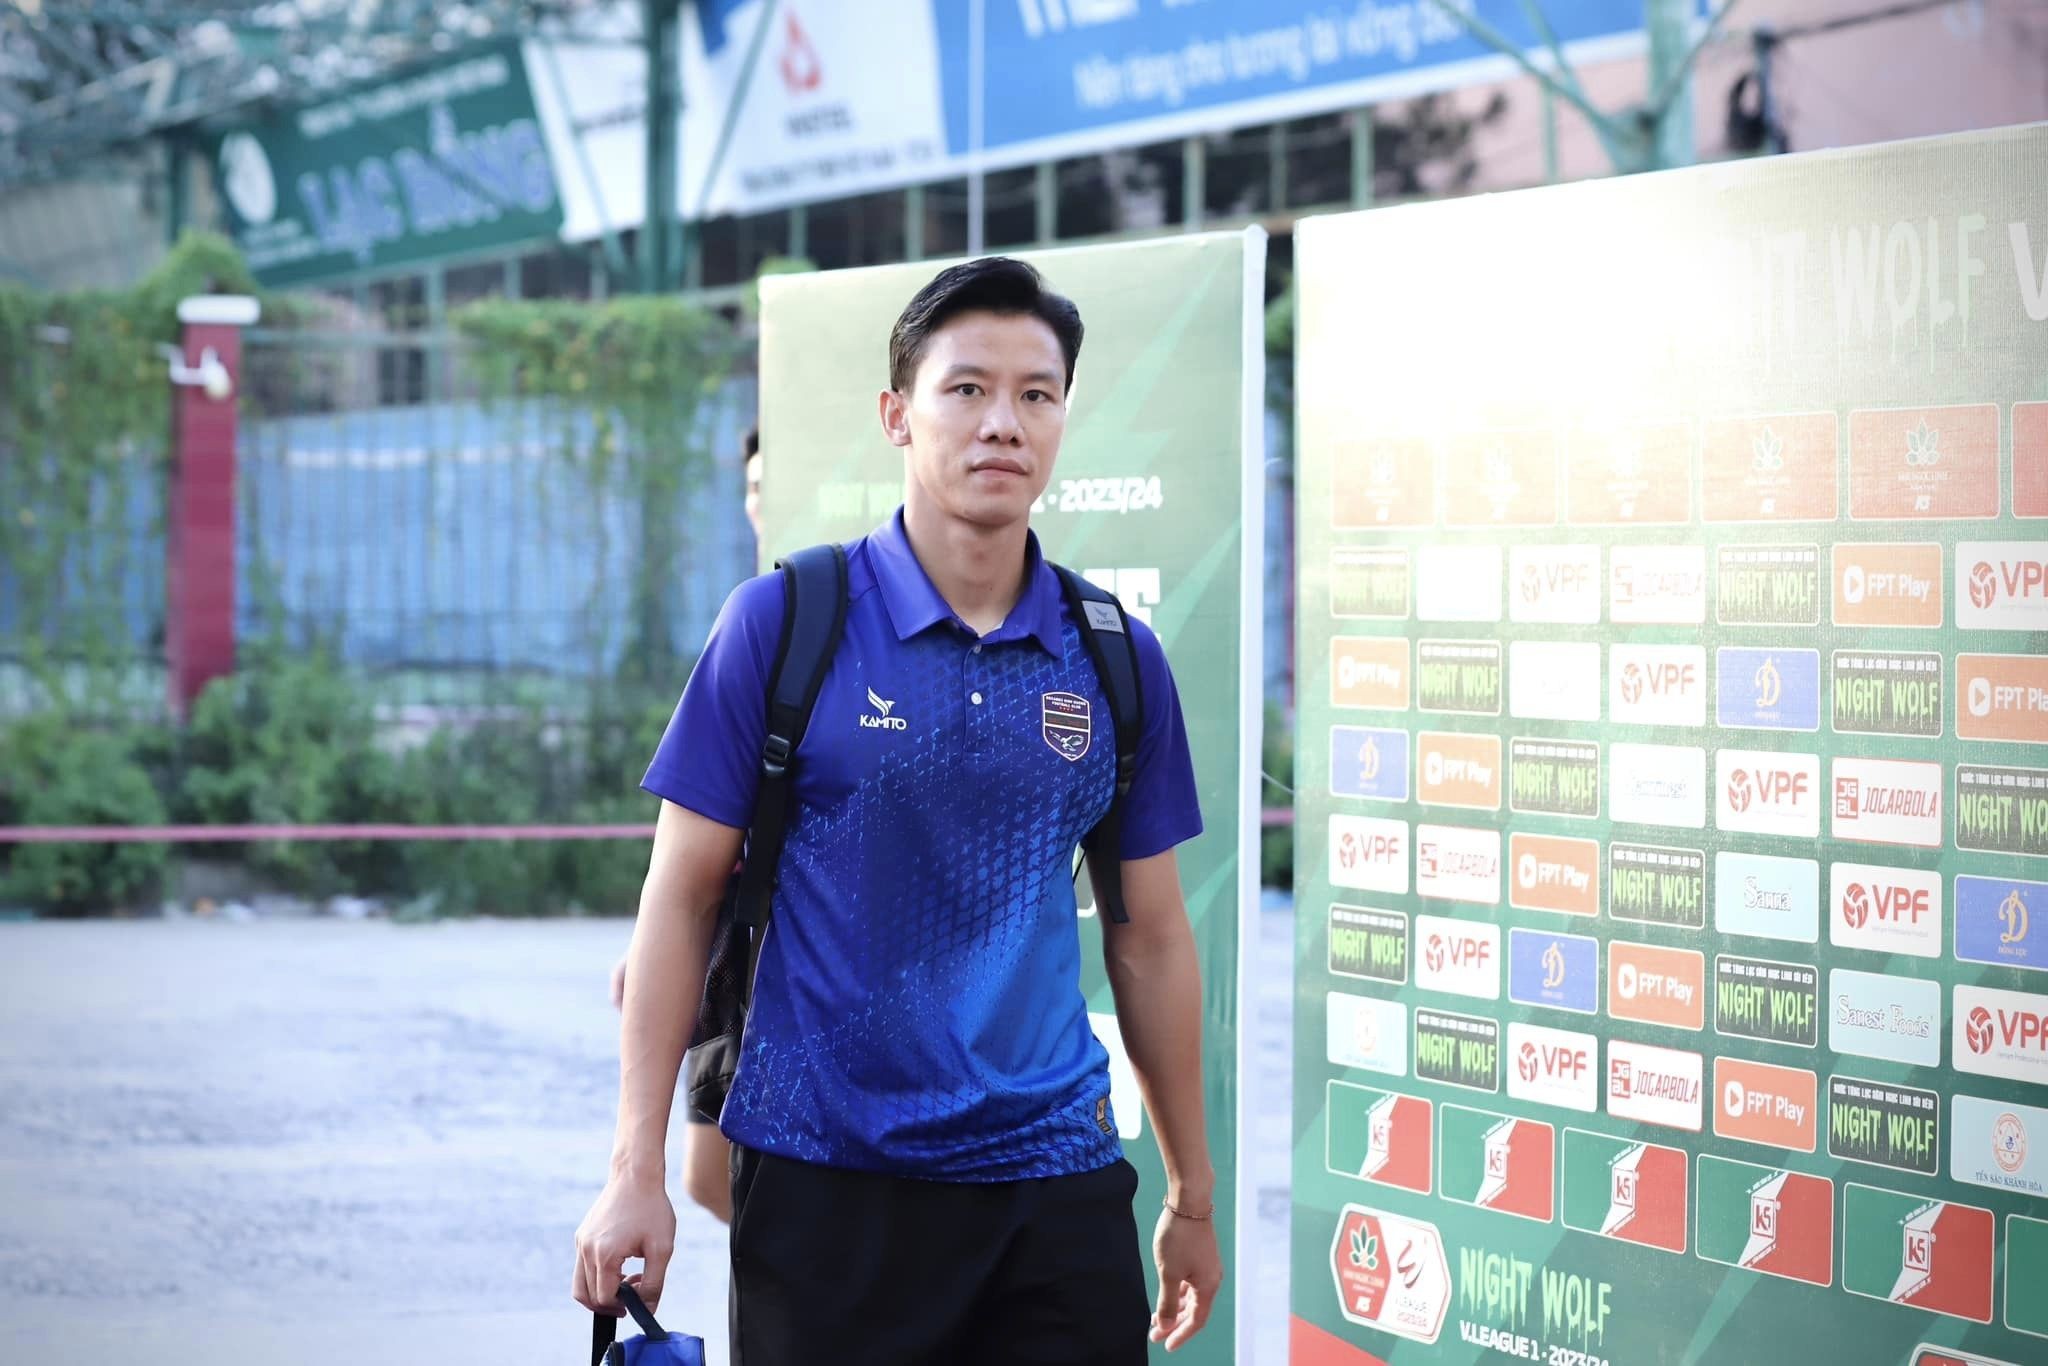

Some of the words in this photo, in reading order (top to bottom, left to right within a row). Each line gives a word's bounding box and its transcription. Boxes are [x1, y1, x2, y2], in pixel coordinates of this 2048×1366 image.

[1831, 214, 1986, 370] WOLF
[1060, 476, 1163, 514] 2023/24
[1719, 567, 1767, 612] NIGHT
[1772, 569, 1815, 612] WOLF
[1867, 573, 1896, 597] FPT
[1899, 573, 1932, 603] Play
[2000, 560, 2048, 598] VP
[1647, 663, 1695, 694] VPF
[1836, 675, 1884, 727] NIGHT
[1892, 679, 1938, 729] WOLF
[1995, 686, 2024, 710] FPT
[860, 713, 907, 730] KAMITO
[1513, 760, 1554, 807] NIGHT
[1558, 763, 1597, 812] WOLF
[1756, 769, 1808, 805] VPF
[1862, 787, 1938, 818] JOGARBOLA
[1960, 790, 2013, 844] NIGHT
[1360, 834, 1400, 864] VPF
[1539, 863, 1562, 883] FPT
[1563, 864, 1591, 893] Play
[1613, 867, 1656, 913] NIGHT
[1660, 872, 1701, 921] WOLF
[1871, 884, 1929, 923] VPF
[1333, 927, 1368, 966] NIGHT
[1370, 933, 1405, 976] WOLF
[1448, 936, 1490, 968] VPF
[1639, 976, 1665, 999] FPT
[1666, 977, 1694, 1006] Play
[1719, 980, 1765, 1031] NIGHT
[1770, 987, 1814, 1038] WOLF
[1838, 994, 1885, 1031] Sanest
[1889, 1003, 1929, 1039] Foods
[1418, 1031, 1457, 1076] NIGHT
[1460, 1039, 1496, 1084] WOLF
[1542, 1044, 1587, 1080] VPF
[1634, 1070, 1699, 1105] JOGARBOLA
[1747, 1090, 1772, 1115] FPT
[1775, 1094, 1805, 1127] Play
[1832, 1102, 1881, 1155] NIGHT
[1888, 1112, 1935, 1165] WOLF
[1460, 1246, 1532, 1330] NIGHT
[1541, 1265, 1612, 1354] WOLF
[1459, 1319, 1529, 1358] V.LEAGUE
